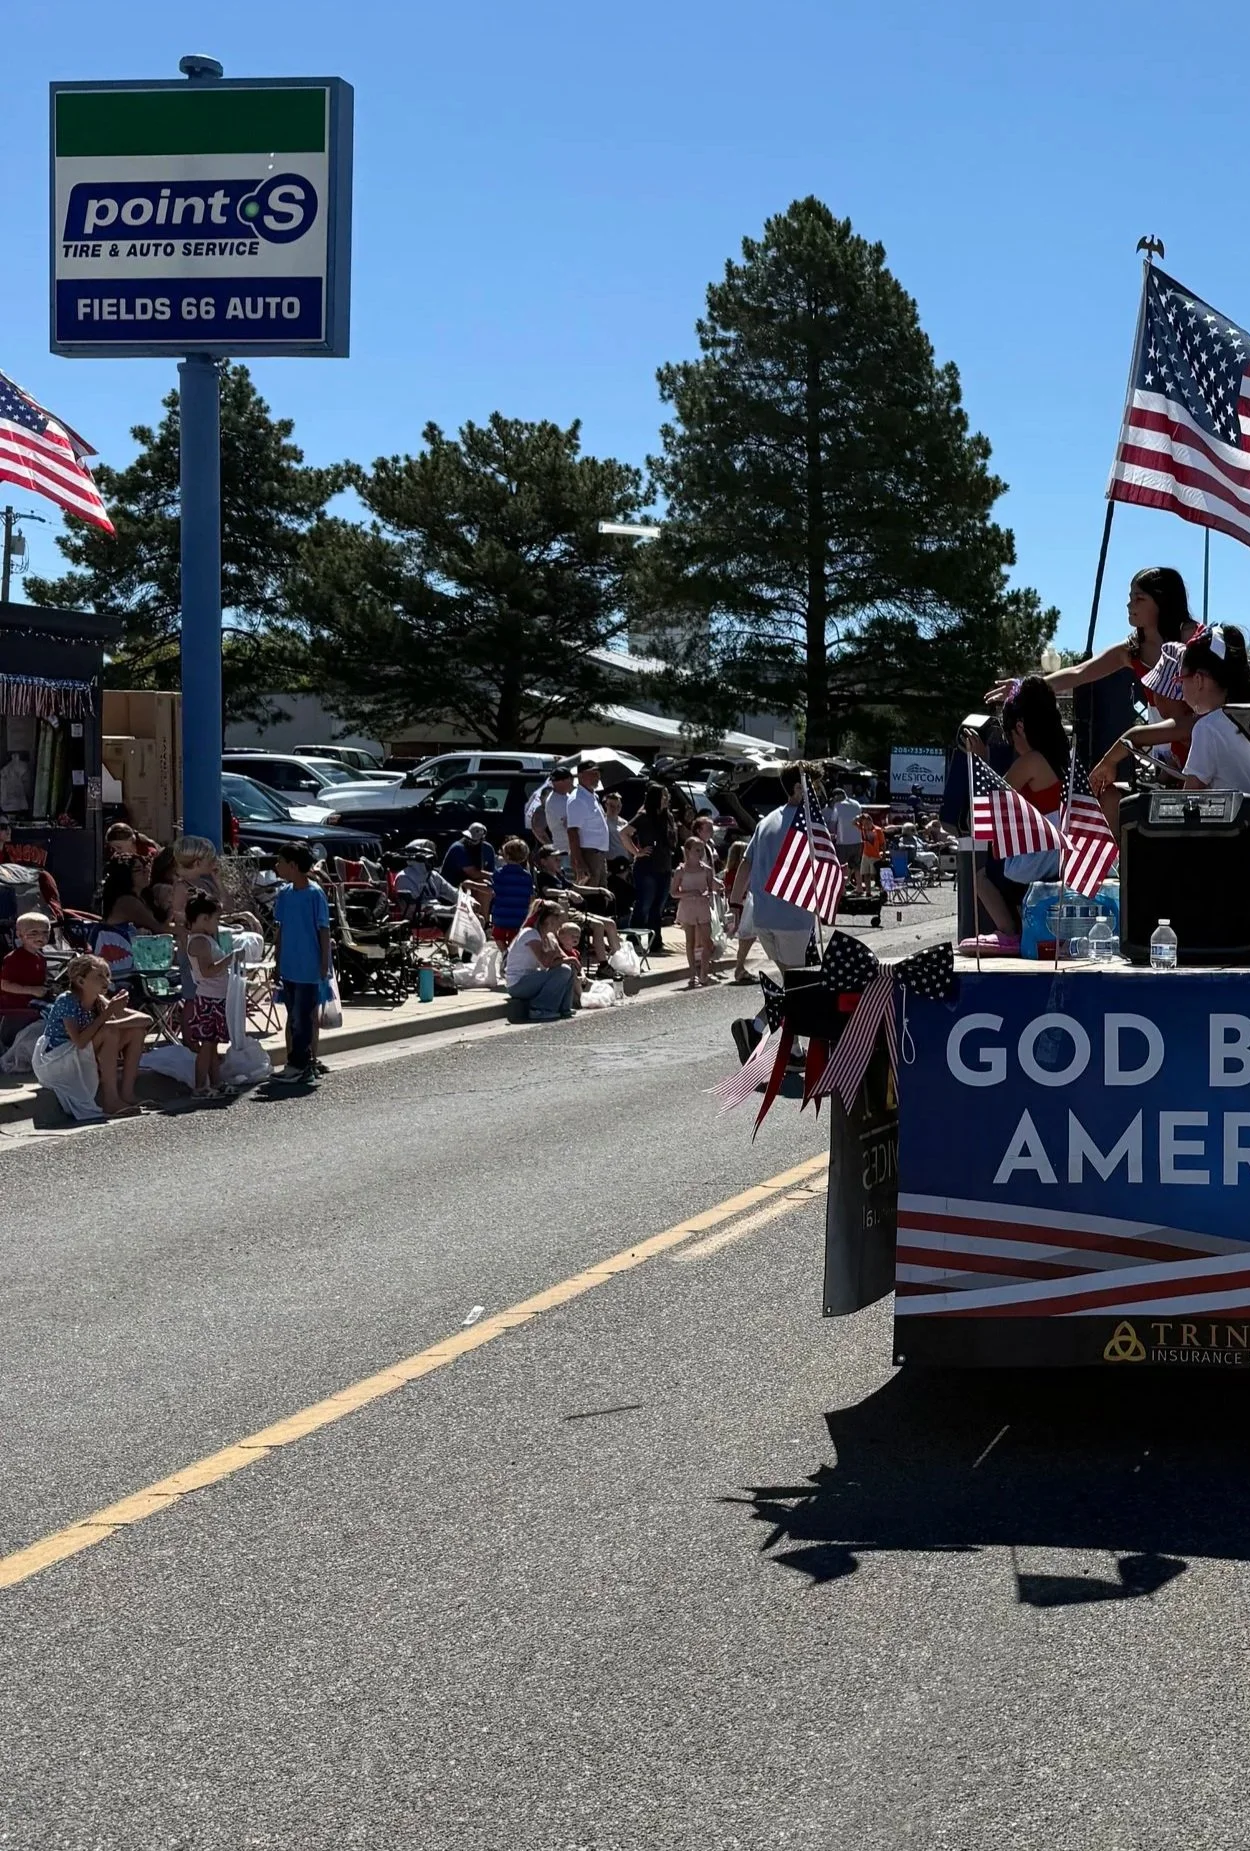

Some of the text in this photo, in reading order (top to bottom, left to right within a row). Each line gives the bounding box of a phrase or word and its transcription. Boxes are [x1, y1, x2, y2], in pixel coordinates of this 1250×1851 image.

[84, 184, 306, 234] point S
[62, 241, 260, 258] TIRE & AUTO SERVICE
[76, 296, 301, 321] FIELDS 66 AUTO
[946, 1012, 1165, 1087] GOD
[1151, 1349, 1242, 1365] INSURANCE
